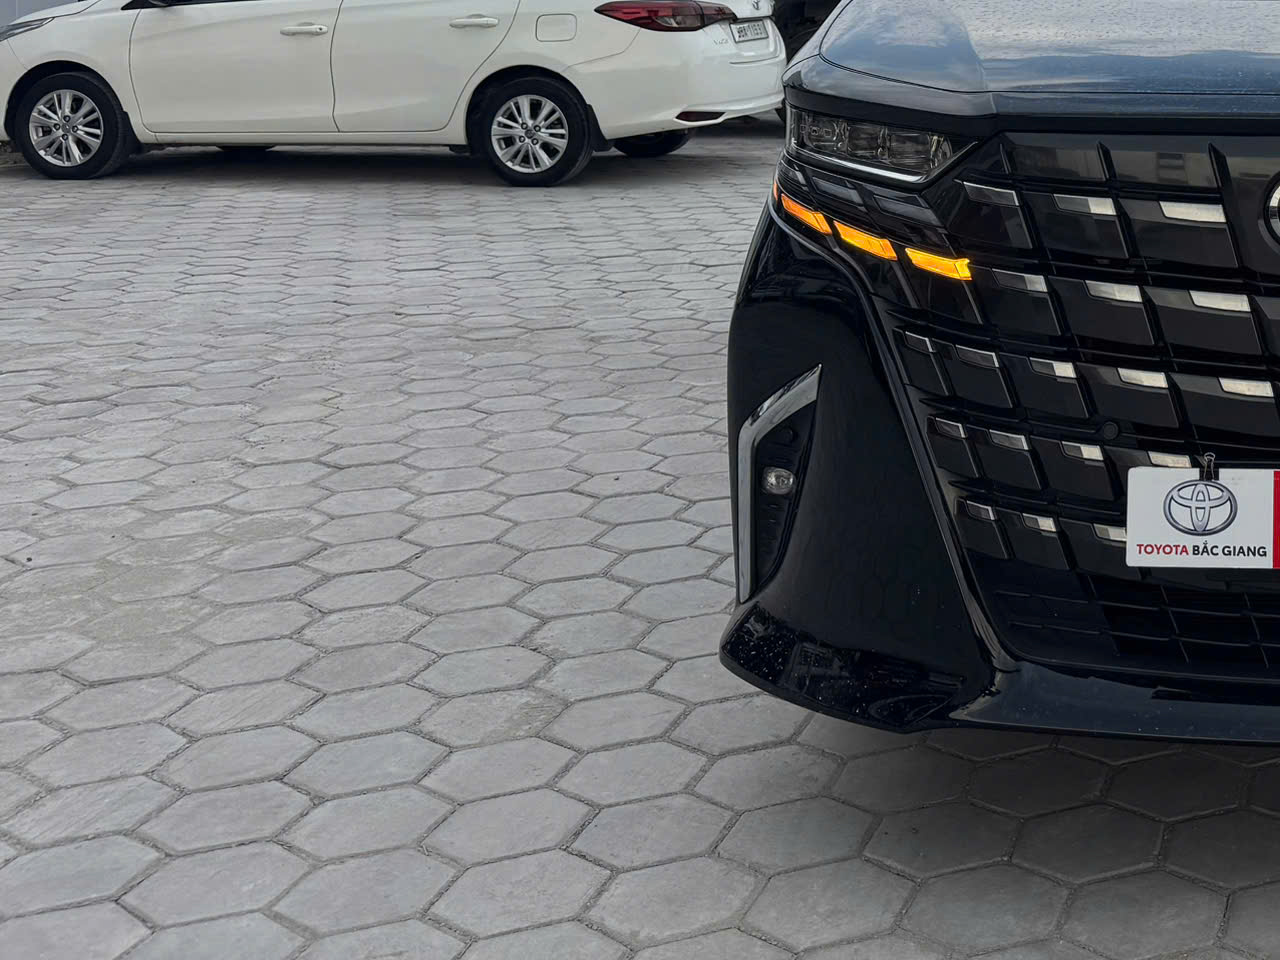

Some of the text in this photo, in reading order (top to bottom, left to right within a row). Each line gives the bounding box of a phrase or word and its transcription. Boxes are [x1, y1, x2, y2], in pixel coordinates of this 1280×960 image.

[1136, 540, 1267, 557] TOYOTA BẮC GIANG
